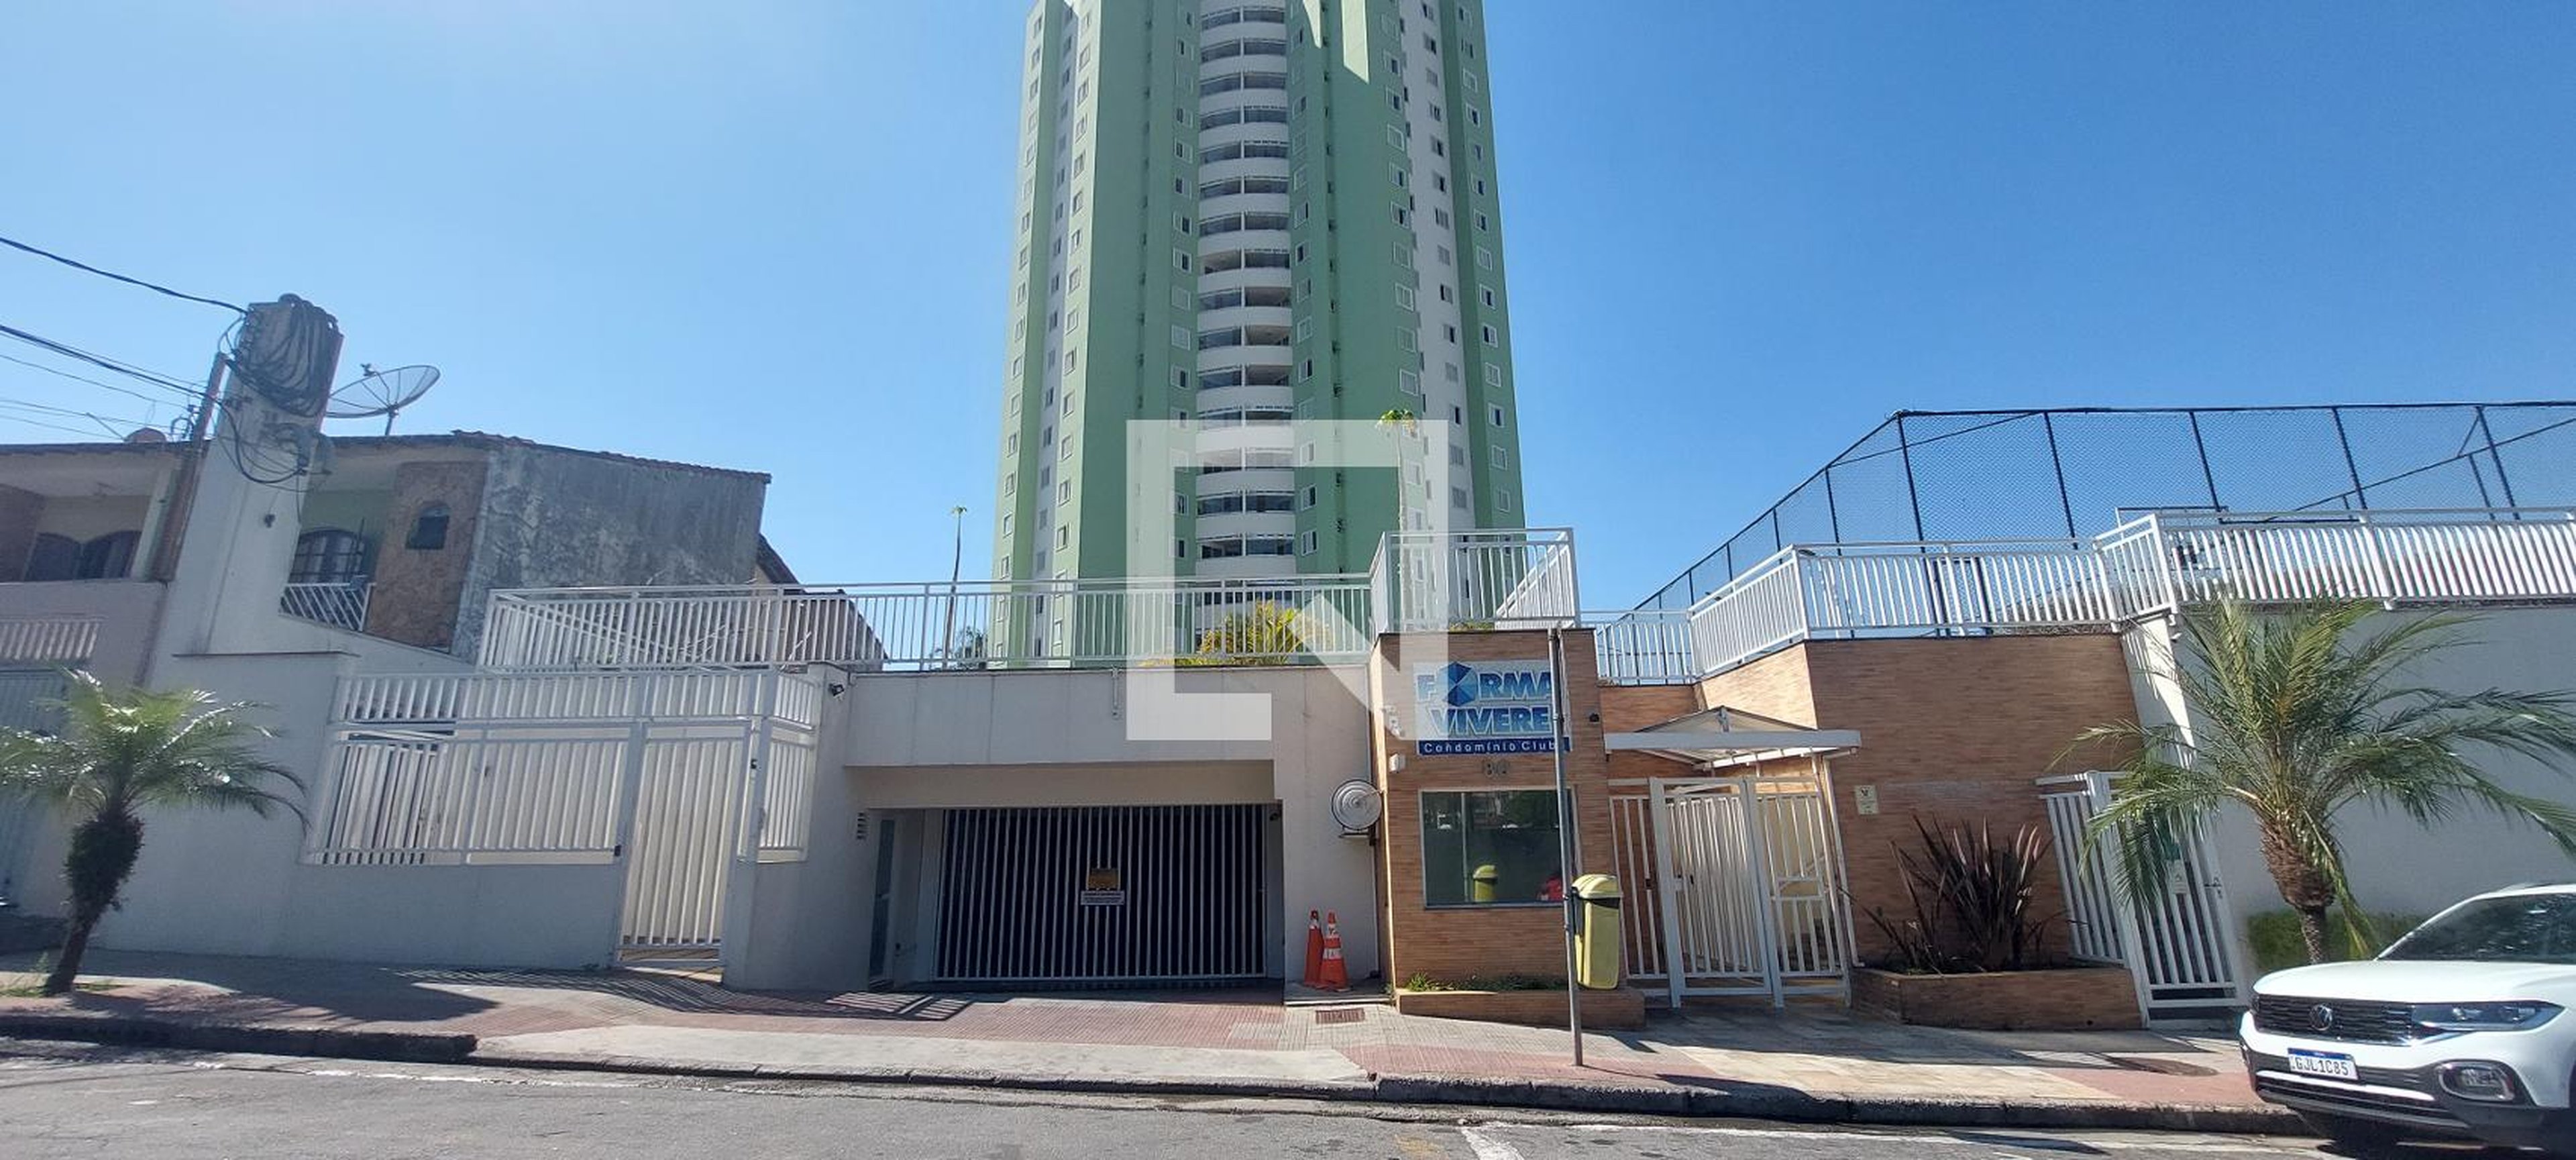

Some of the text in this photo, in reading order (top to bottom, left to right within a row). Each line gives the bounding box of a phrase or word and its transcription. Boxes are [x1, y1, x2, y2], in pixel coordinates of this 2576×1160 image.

[1415, 662, 1552, 706] FORMA
[1430, 706, 1552, 735] VIVERE
[1424, 739, 1555, 753] Condomínio Club
[2294, 1056, 2349, 1076] GJL1C85
